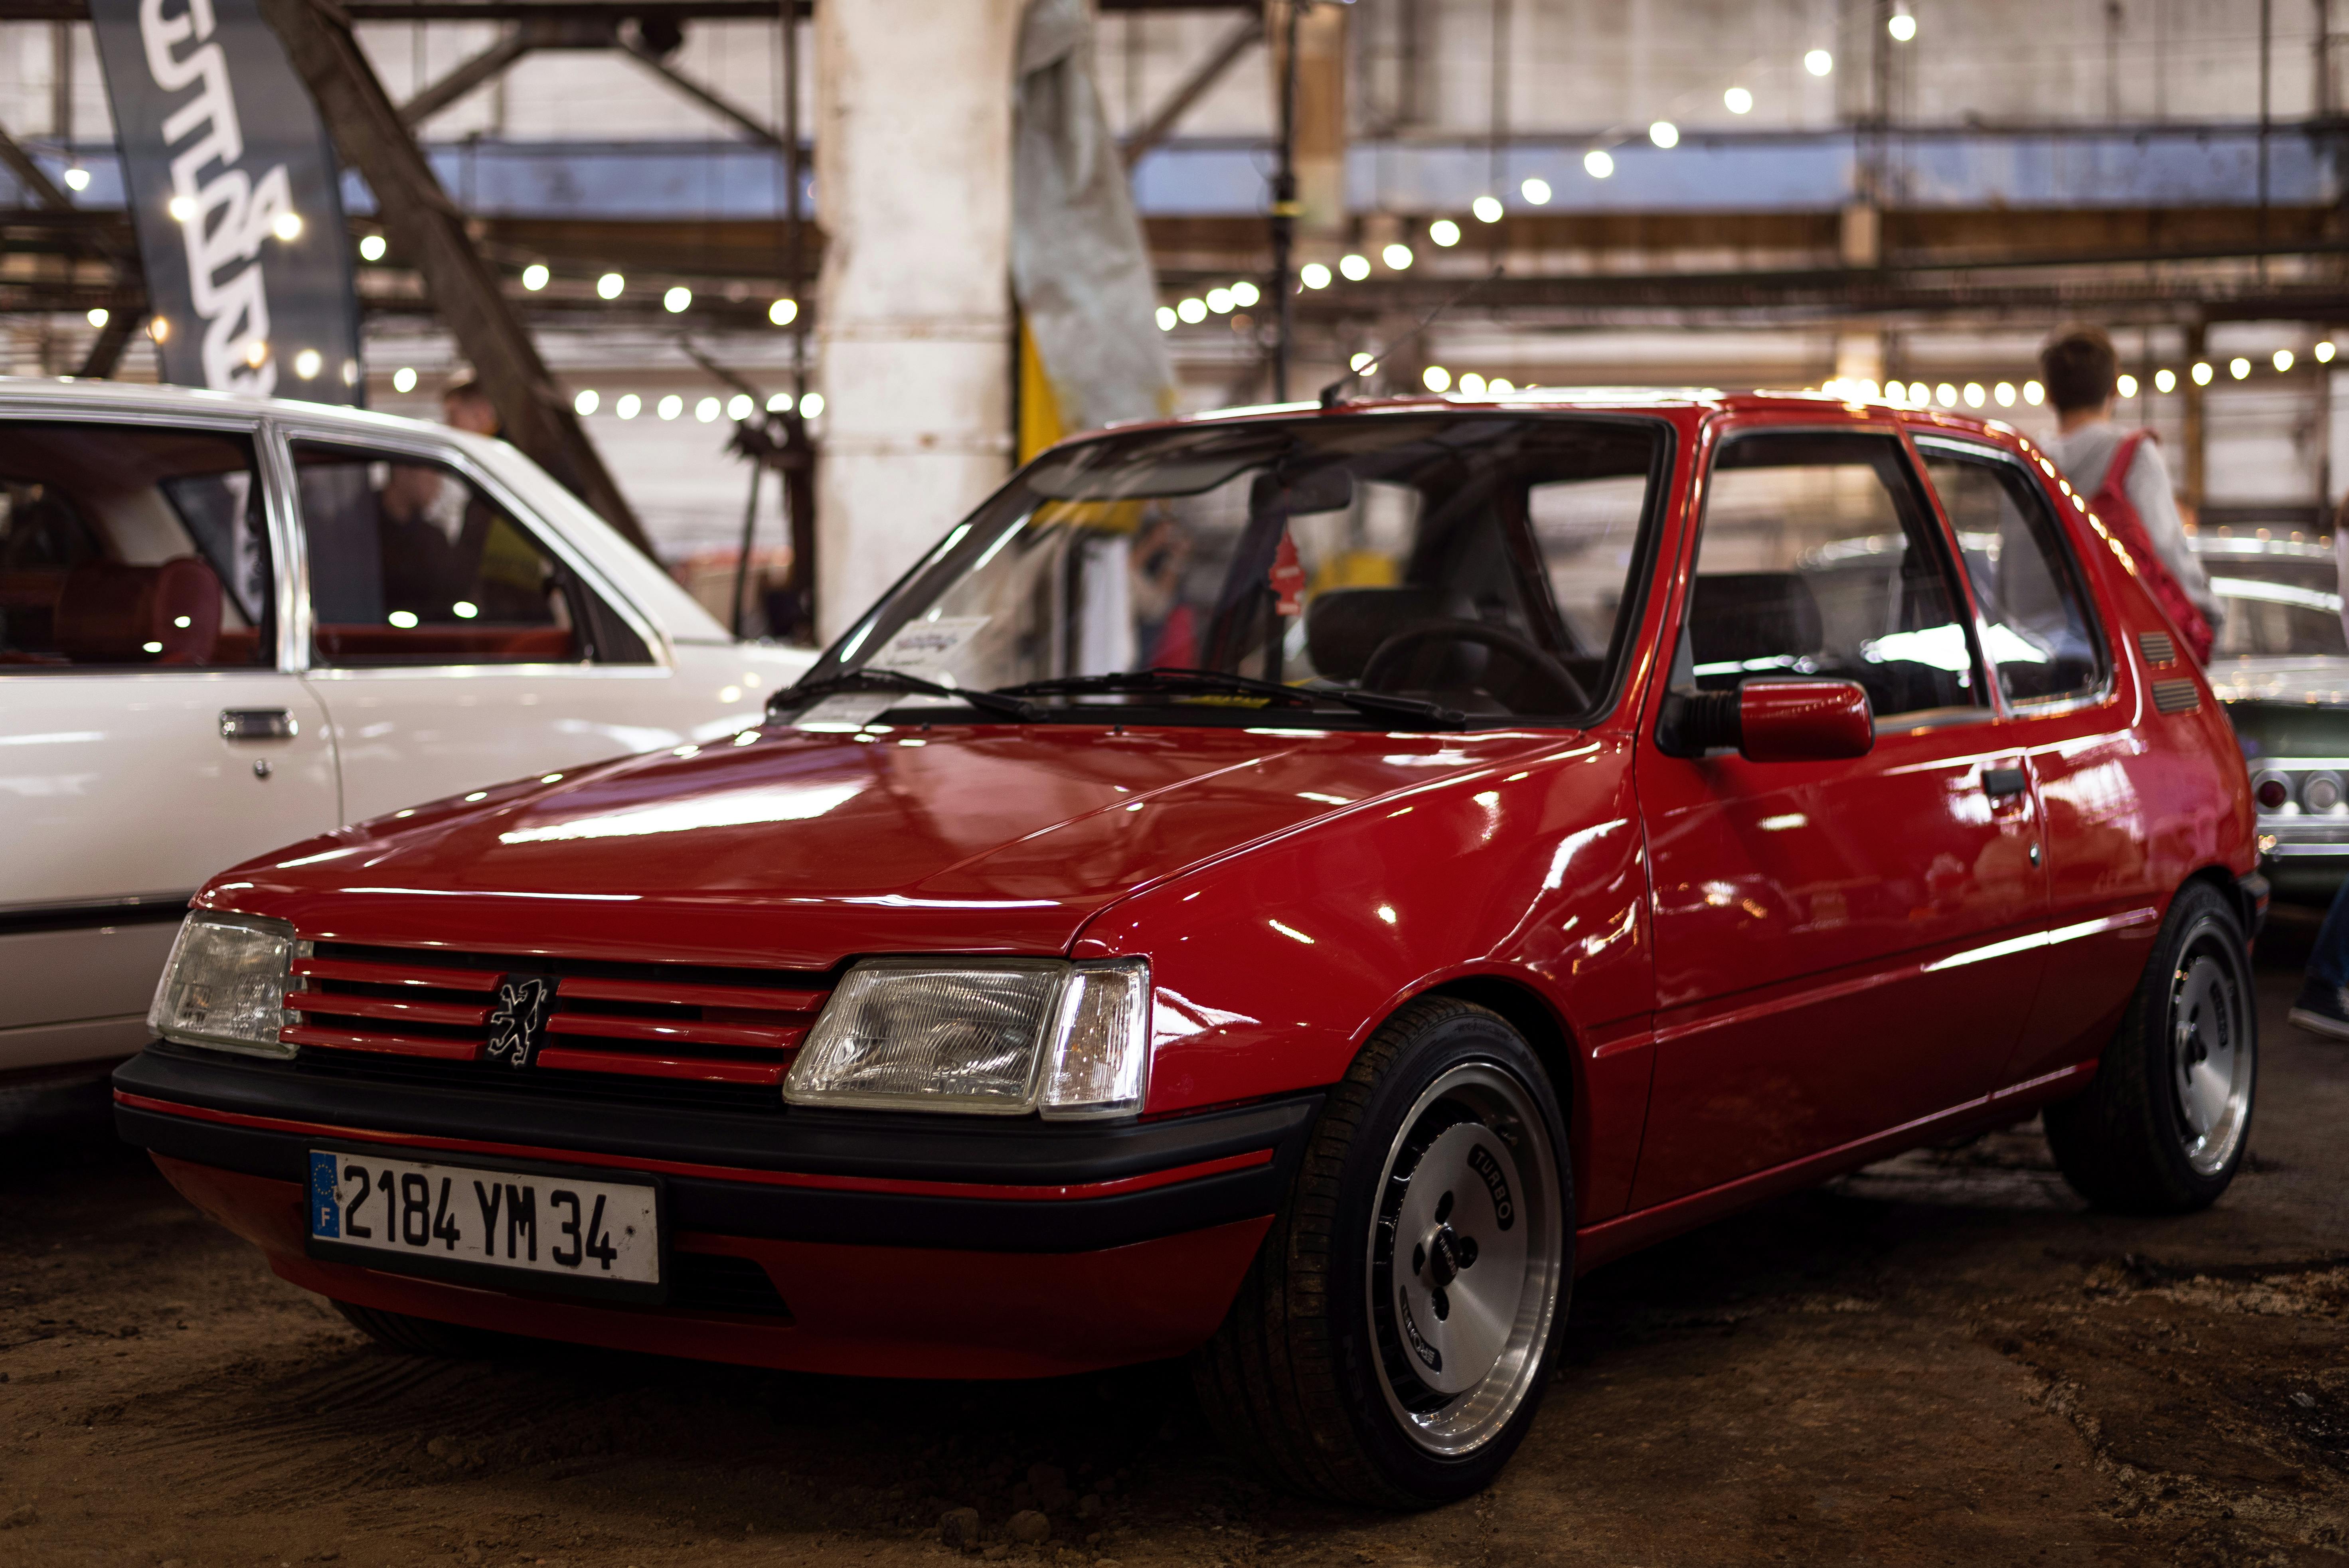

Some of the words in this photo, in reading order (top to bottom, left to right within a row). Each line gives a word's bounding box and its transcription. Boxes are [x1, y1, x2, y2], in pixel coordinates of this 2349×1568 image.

[321, 1207, 330, 1227] F
[344, 1165, 460, 1250] 2184
[474, 1180, 537, 1262] YM
[551, 1189, 618, 1270] 34
[1476, 1151, 1511, 1219] TURBO
